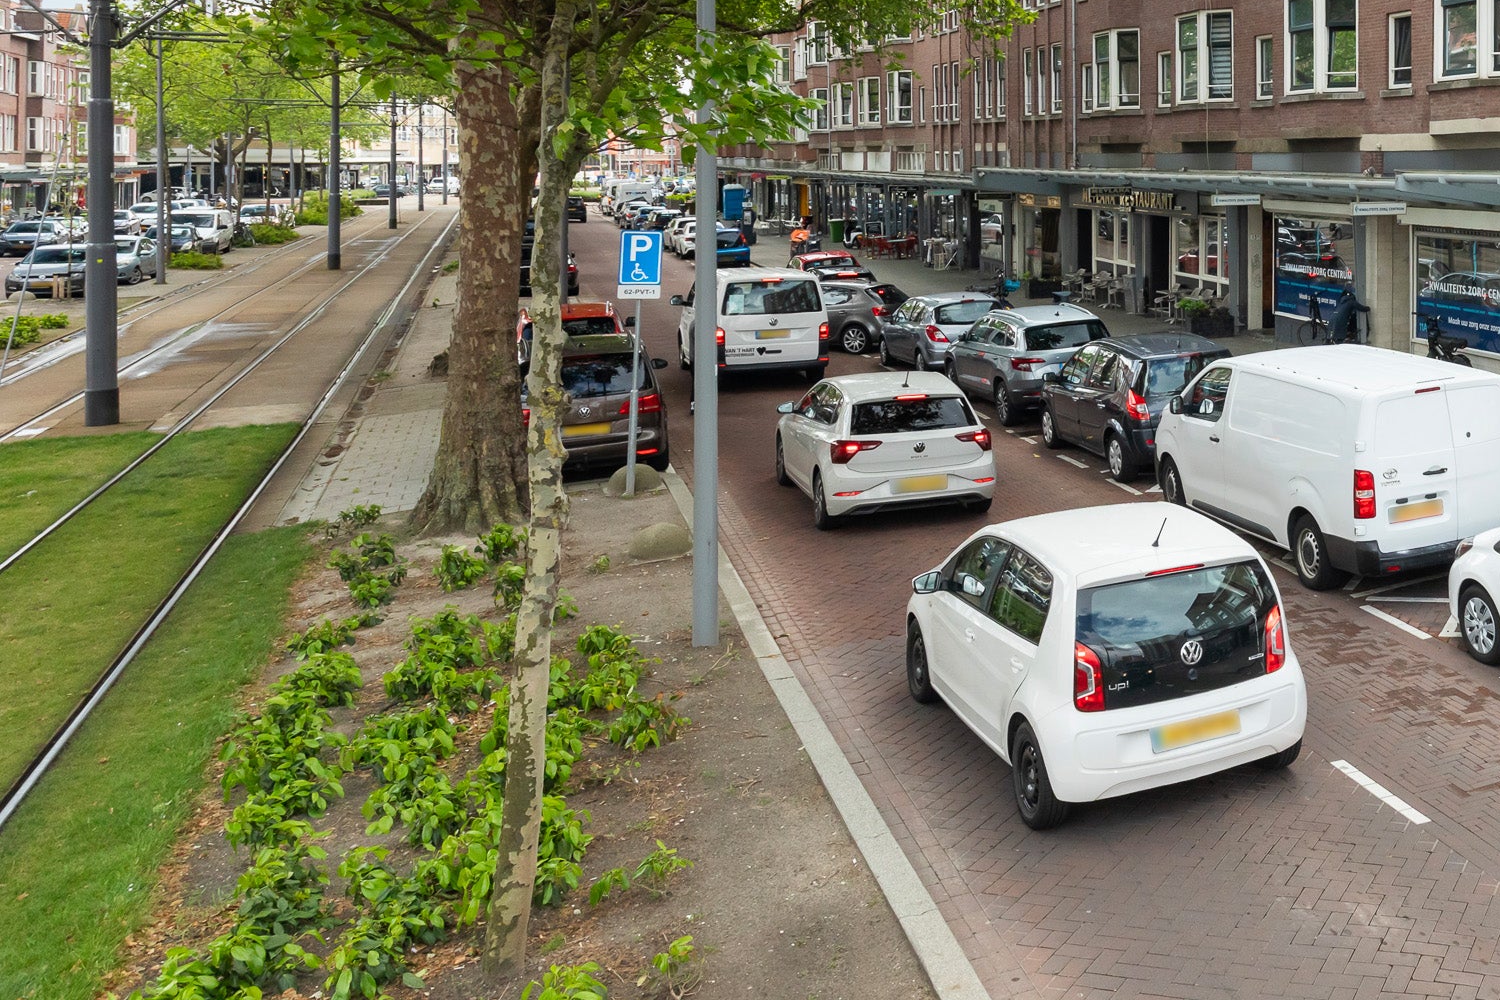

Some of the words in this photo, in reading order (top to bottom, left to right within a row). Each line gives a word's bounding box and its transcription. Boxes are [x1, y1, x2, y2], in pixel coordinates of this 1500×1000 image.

[629, 234, 653, 262] P
[1312, 266, 1327, 278] ZORG
[1327, 268, 1352, 280] CENTRUM
[1428, 281, 1466, 295] KWALITEITS
[1467, 286, 1487, 300] ZORG
[1468, 321, 1479, 331] zorg
[1490, 325, 1500, 335] zorg
[1108, 680, 1129, 691] up!
